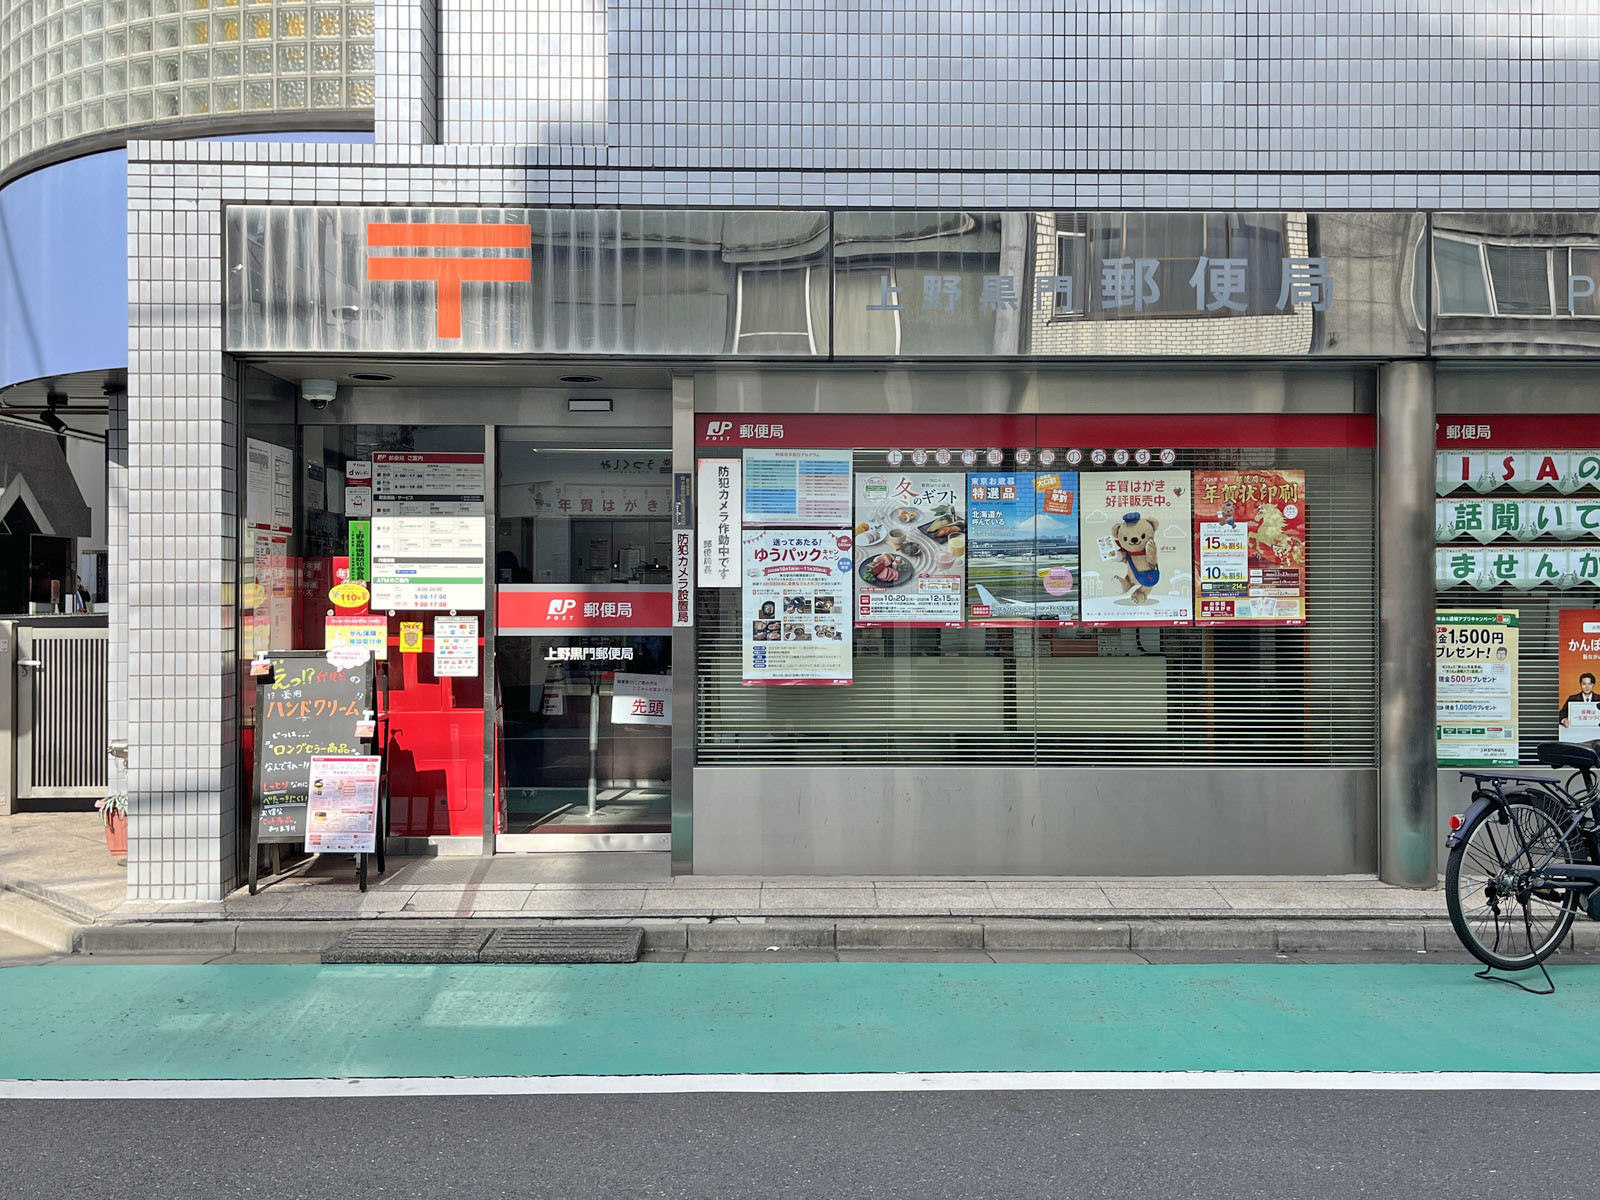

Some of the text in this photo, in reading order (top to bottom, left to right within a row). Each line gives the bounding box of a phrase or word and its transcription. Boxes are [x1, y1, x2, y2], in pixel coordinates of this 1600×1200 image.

[866, 256, 1335, 312] 上野黒門郵便局
[1568, 275, 1600, 312] P
[739, 424, 784, 439] 郵便局
[1446, 424, 1491, 439] 郵便局
[971, 477, 1015, 485] 東京お歳暮
[1105, 480, 1166, 493] 年賀はがき
[892, 477, 957, 506] 冬のギフト
[971, 486, 1016, 500] 特選品
[1202, 483, 1299, 504] 年賀状印刷
[1105, 495, 1171, 508] 好評販売中。
[972, 510, 1003, 518] 北海道が
[1454, 503, 1600, 531] 話聞いて
[718, 466, 730, 580] 防犯カメラ作動中です
[971, 518, 1006, 526] 呼んでいる
[754, 548, 821, 562] ゆうパック
[677, 533, 689, 623] 防犯カメラ設置局
[583, 602, 633, 618] 郵便局
[1436, 629, 1504, 644] 金1,500円
[544, 647, 634, 661] 上野黒門郵便局
[1436, 645, 1491, 659] プレゼント!
[1438, 675, 1497, 683] 現金500円プレゼント
[266, 699, 360, 718] ハンドクリーム
[631, 699, 664, 715] 先頭
[273, 742, 350, 756] ロングセラー商品
